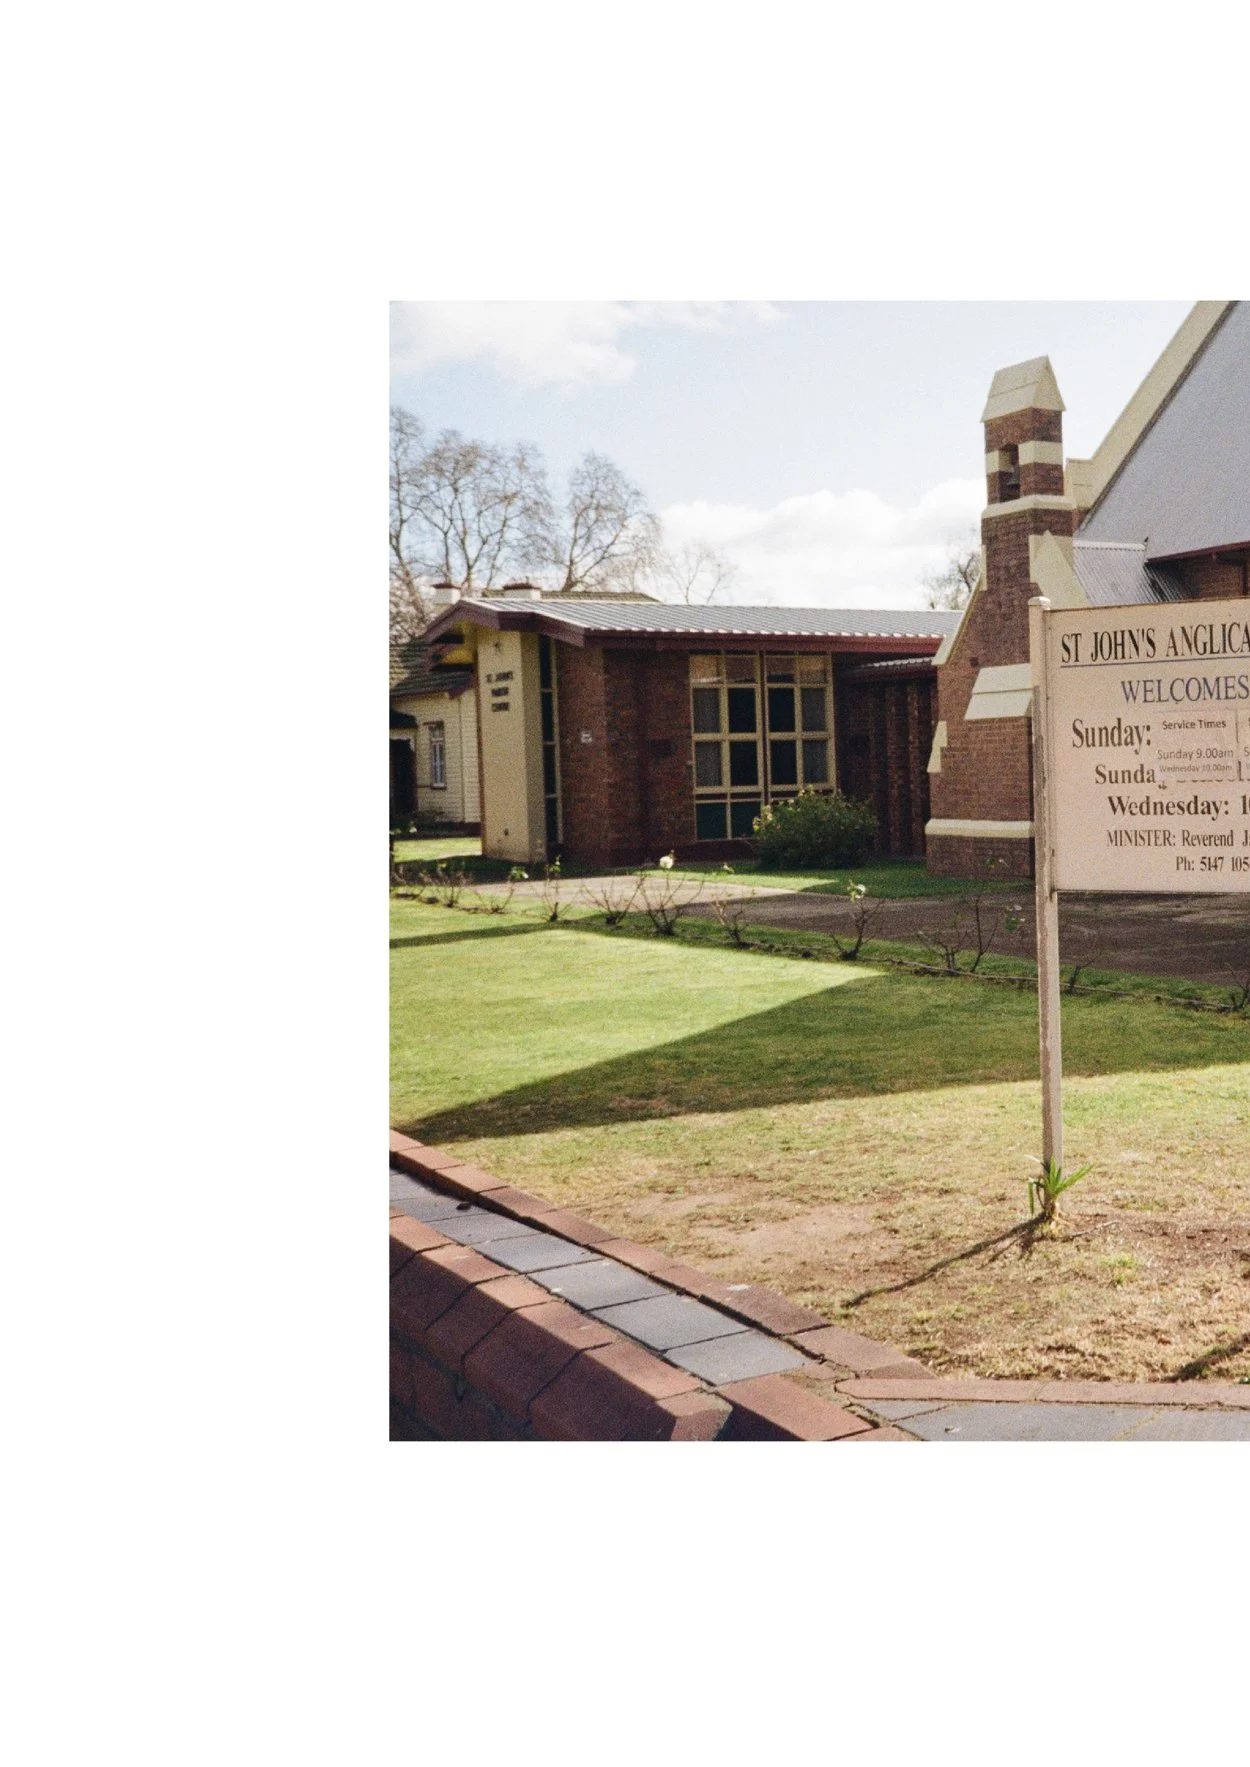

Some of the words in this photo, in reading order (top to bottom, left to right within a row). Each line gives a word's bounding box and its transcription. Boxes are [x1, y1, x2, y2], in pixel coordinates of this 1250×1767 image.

[1061, 632, 1082, 663] ST
[1091, 627, 1156, 661] JOHN'S
[1120, 675, 1250, 704] WELCOMES
[1162, 720, 1196, 730] Service
[1199, 719, 1226, 729] Times
[1072, 718, 1151, 755] Sunday:
[1157, 749, 1193, 761] Sunday
[1160, 764, 1199, 773] Wednesday
[1107, 796, 1229, 821] Wednesday:
[1107, 829, 1176, 847] MINISTER:
[1182, 829, 1234, 847] Reverend
[1175, 856, 1195, 871] Ph:
[1200, 856, 1224, 872] 5147
